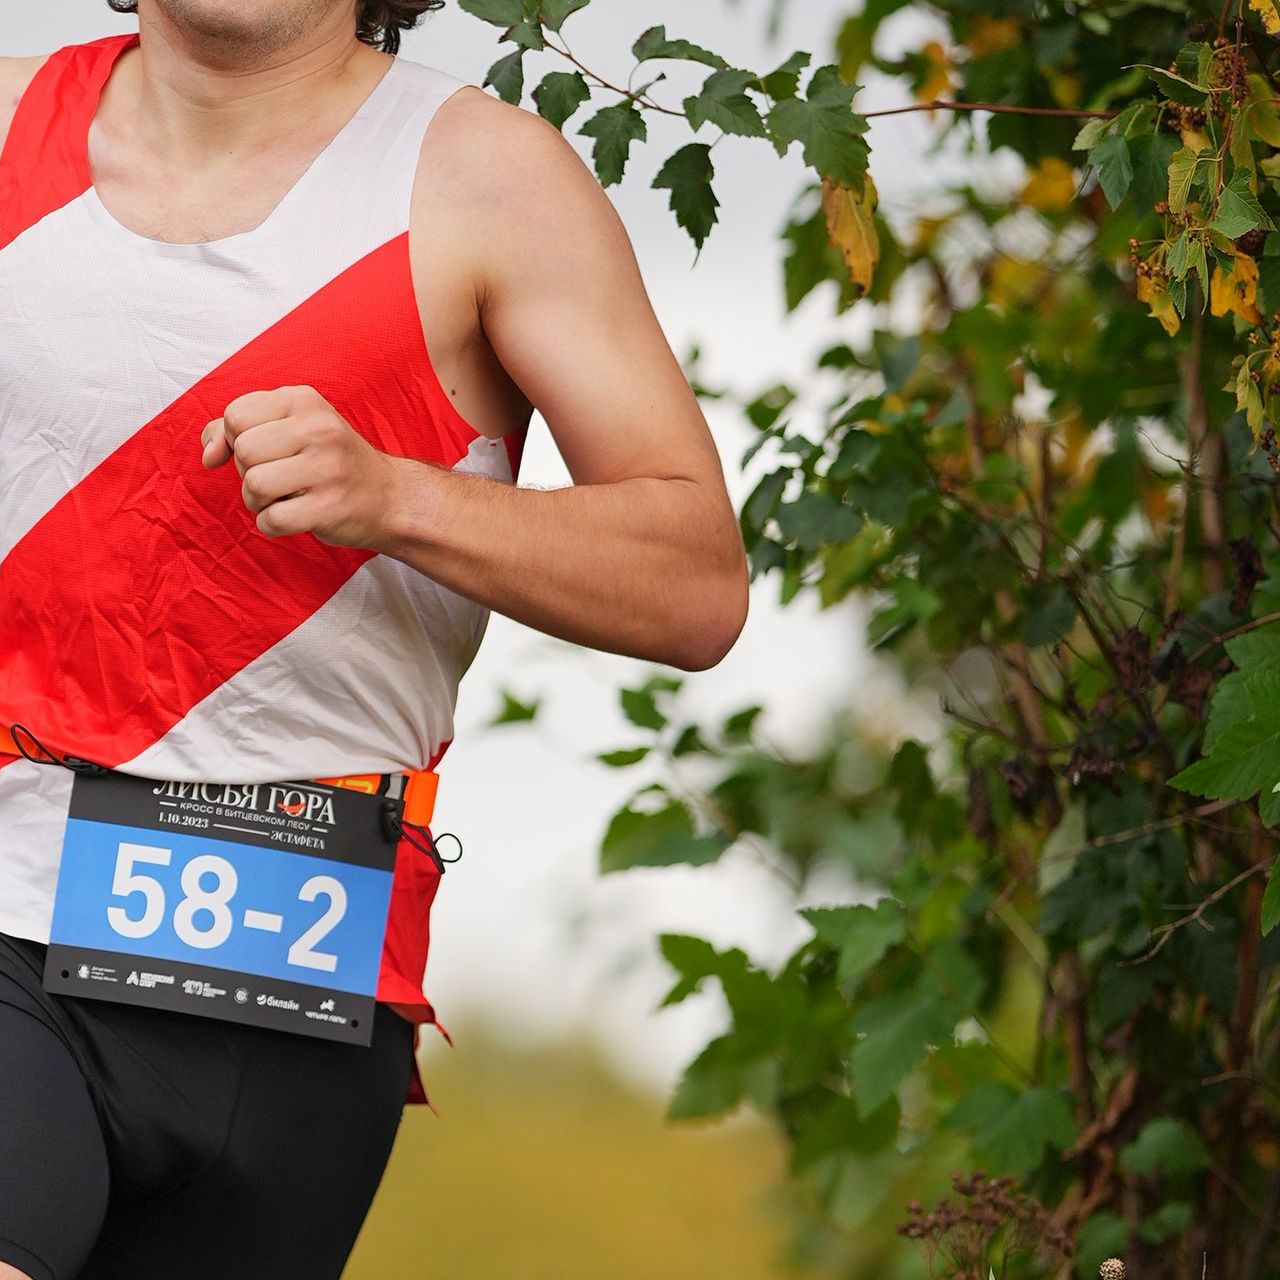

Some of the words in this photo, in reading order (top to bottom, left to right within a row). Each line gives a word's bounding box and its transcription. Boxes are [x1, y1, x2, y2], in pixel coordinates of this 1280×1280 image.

[152, 780, 261, 811] ЛИСЬЯ
[266, 785, 337, 826] ГОРА
[158, 811, 210, 830] 1.10.2023
[179, 801, 214, 815] КРОСС
[215, 807, 222, 816] В
[224, 809, 286, 827] БИТЦЕВСКОМ
[286, 818, 311, 832] ЛЕСУ
[270, 829, 326, 850] ЭСТАФЕТА
[106, 841, 349, 974] 58-2
[266, 995, 300, 1012] билайн
